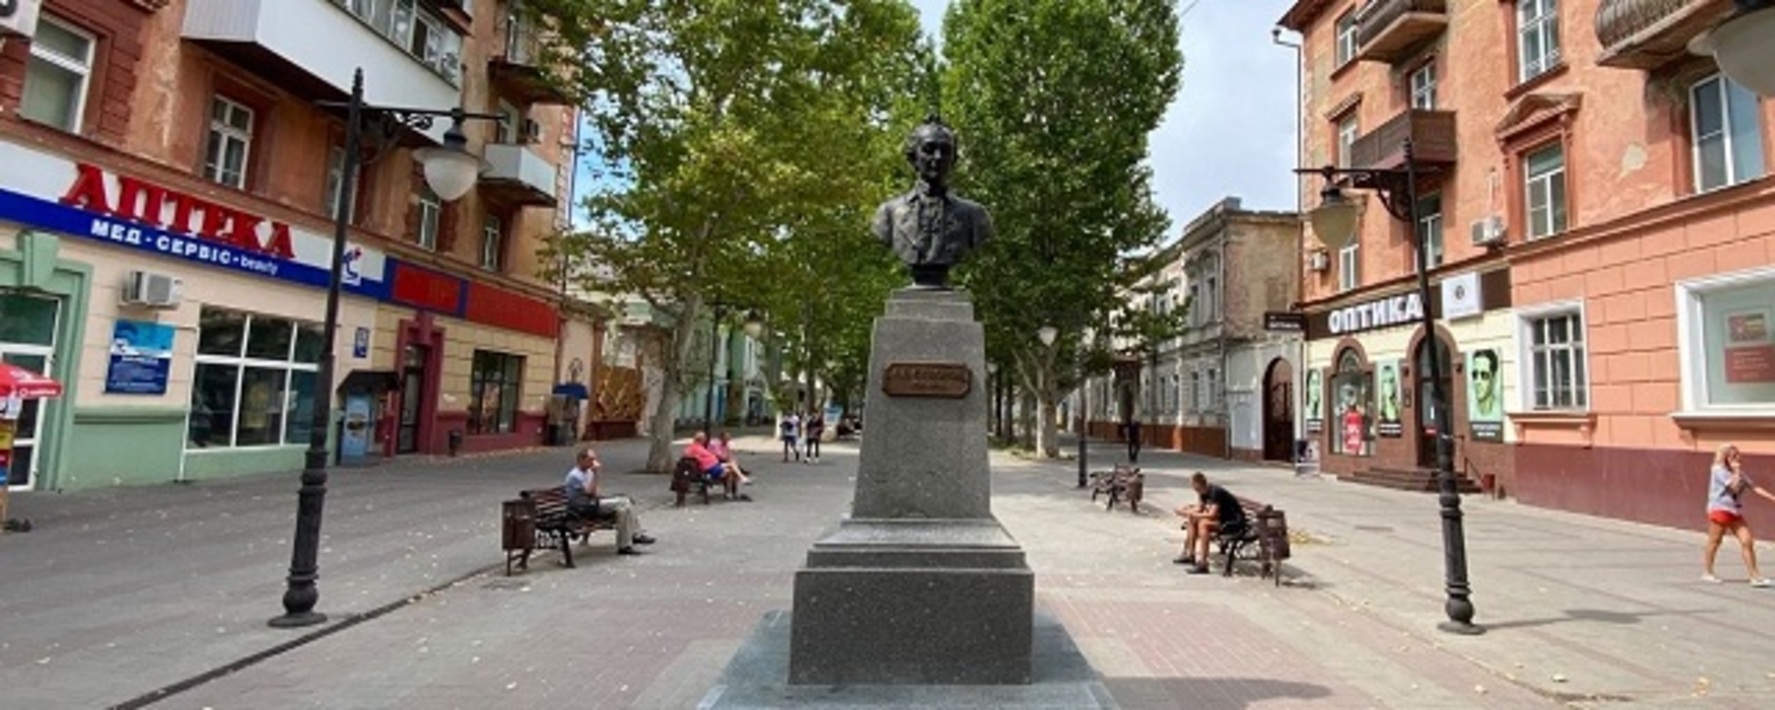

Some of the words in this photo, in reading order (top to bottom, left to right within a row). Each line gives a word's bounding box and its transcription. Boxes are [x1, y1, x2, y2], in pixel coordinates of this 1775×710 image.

[59, 162, 295, 259] АПТЕКА
[91, 218, 142, 245] МЕД
[156, 235, 231, 265] СЕРВІС
[241, 254, 279, 276] beauty
[1328, 293, 1424, 334] ОПТИКА
